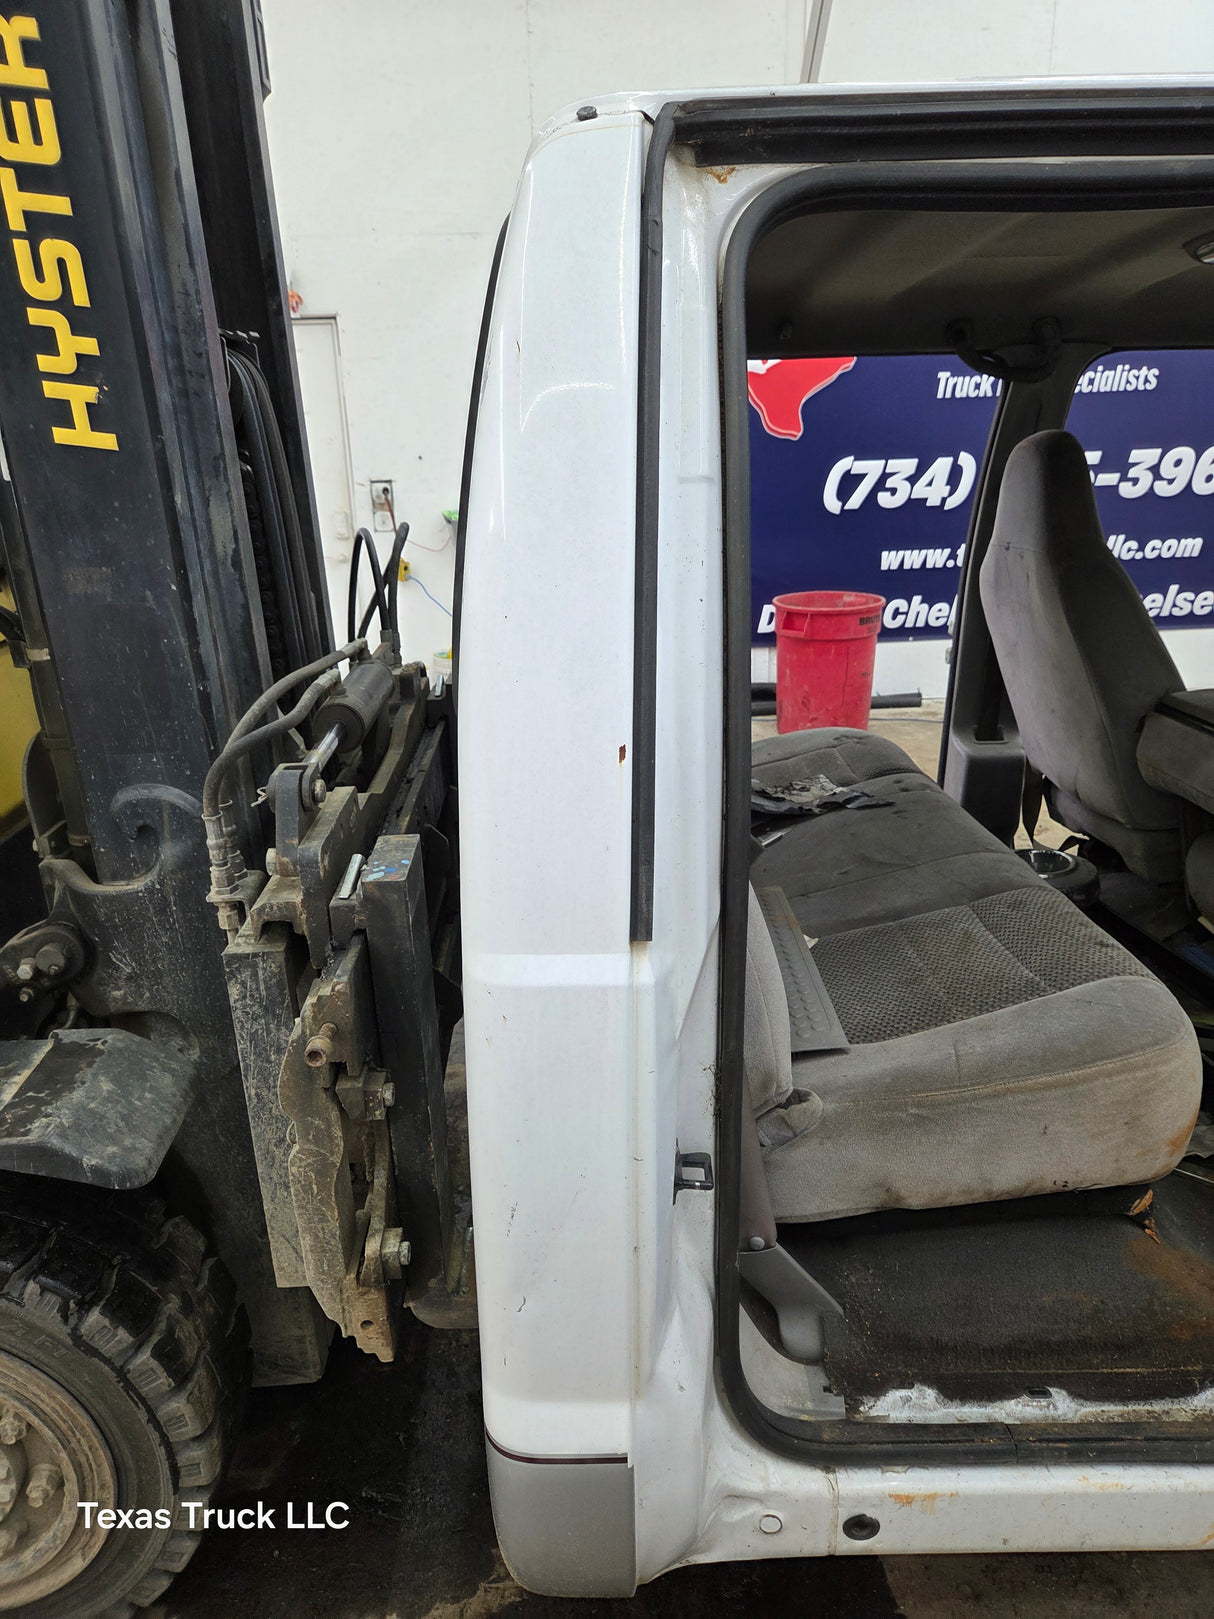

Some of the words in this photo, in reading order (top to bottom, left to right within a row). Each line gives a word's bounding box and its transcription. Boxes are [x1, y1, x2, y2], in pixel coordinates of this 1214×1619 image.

[0, 14, 120, 452] HYSTER
[936, 371, 994, 399] Truck
[823, 450, 977, 515] (734)
[1084, 446, 1214, 499] -396
[880, 543, 966, 571] www.t
[1106, 534, 1204, 560] llc.com
